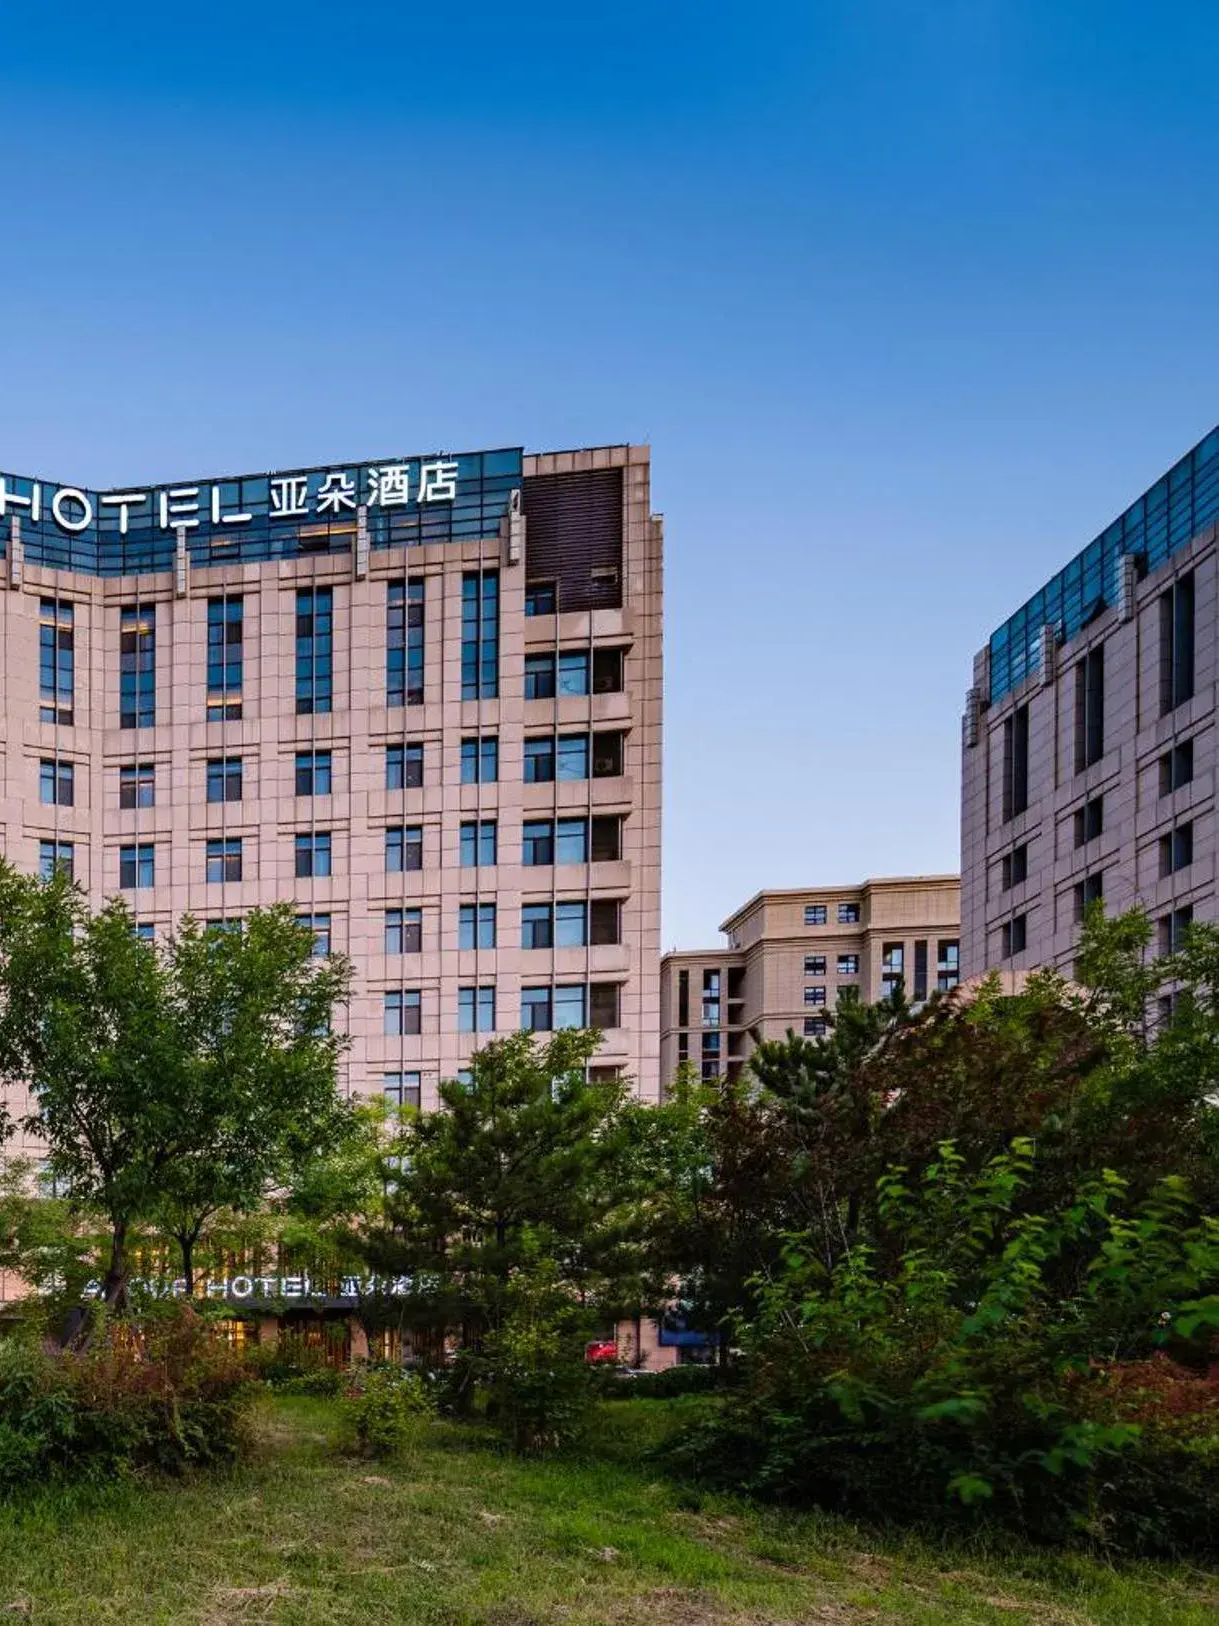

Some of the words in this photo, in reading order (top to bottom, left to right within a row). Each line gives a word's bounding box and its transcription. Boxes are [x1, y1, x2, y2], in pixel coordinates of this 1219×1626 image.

[269, 461, 459, 518] 亚朵酒店
[206, 1276, 327, 1298] HOTEL
